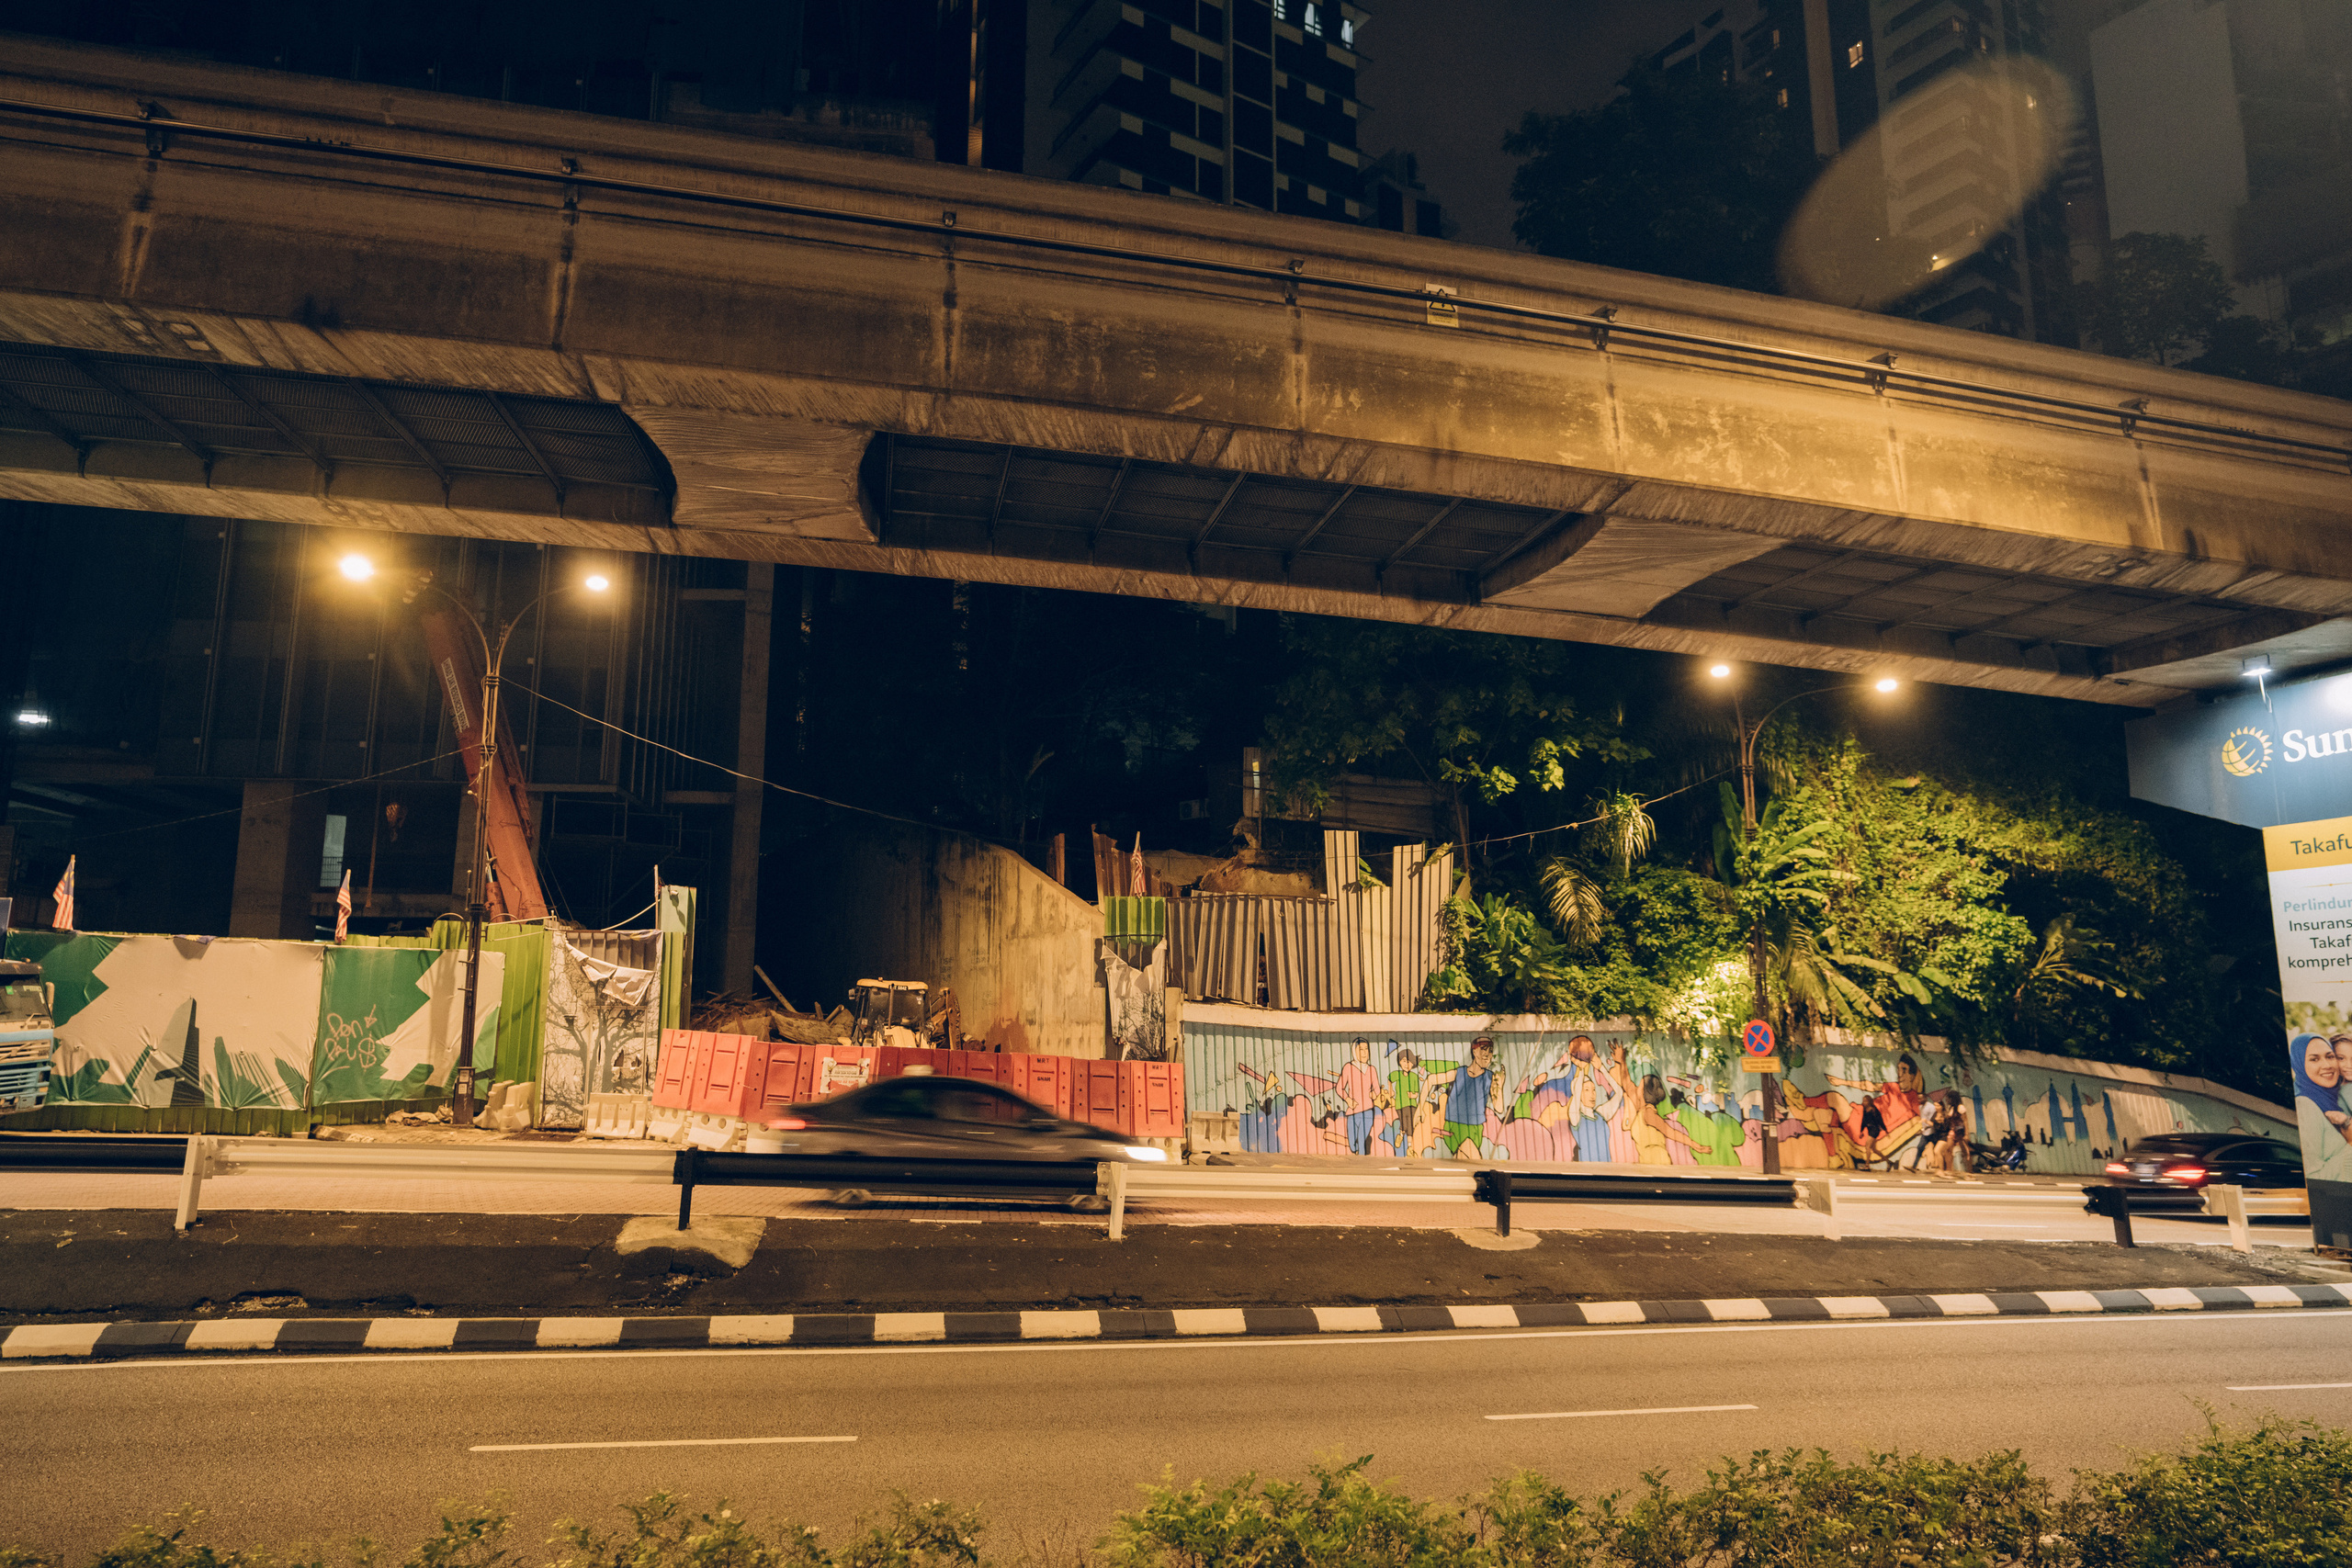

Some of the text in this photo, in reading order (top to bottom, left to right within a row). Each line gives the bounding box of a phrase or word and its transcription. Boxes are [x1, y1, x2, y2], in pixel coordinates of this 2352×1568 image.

[2282, 728, 2352, 762] Sun
[2290, 833, 2352, 855] Takafu
[2289, 919, 2352, 931] Insurans
[2310, 934, 2352, 949] Takaf
